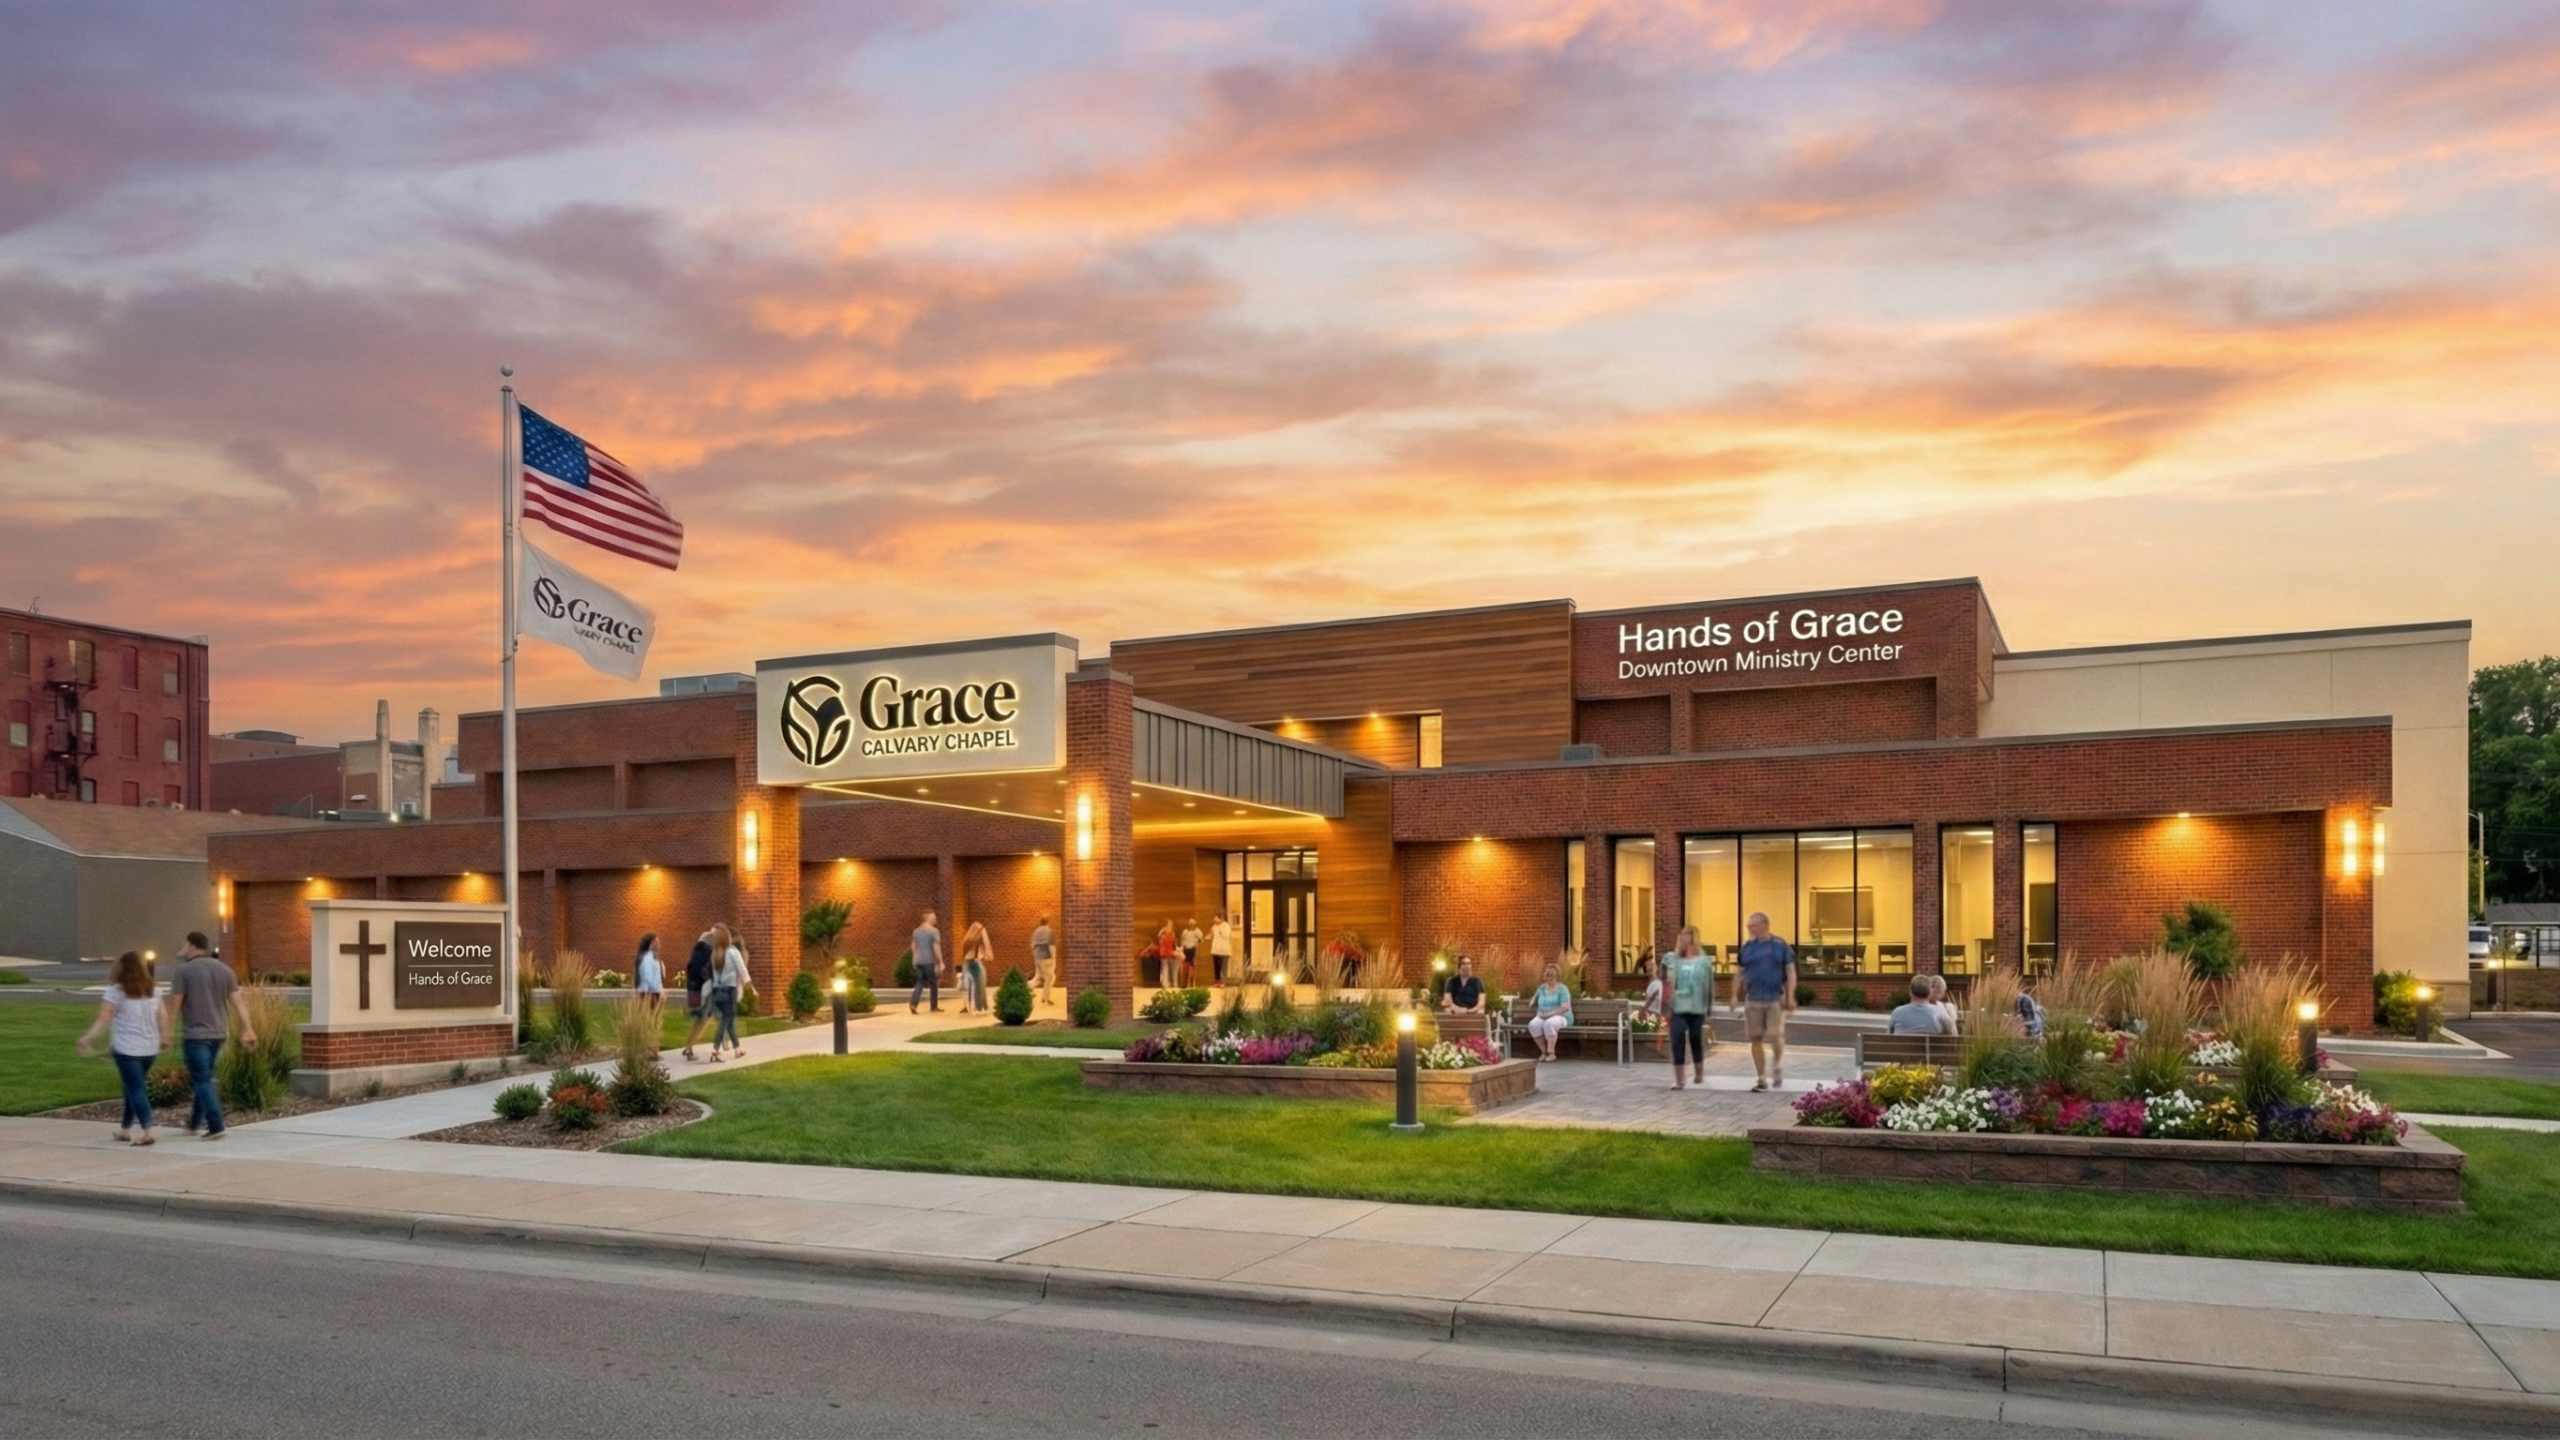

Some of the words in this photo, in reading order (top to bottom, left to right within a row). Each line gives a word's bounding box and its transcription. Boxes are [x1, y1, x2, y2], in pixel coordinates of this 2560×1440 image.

[567, 598, 643, 643] Grace
[1618, 617, 1732, 654] Hands
[1743, 611, 1780, 644] of
[1790, 608, 1903, 640] Grace
[1618, 657, 1728, 679] Downtown
[1736, 650, 1822, 671] Ministry
[1828, 643, 1903, 664] Center
[859, 675, 1016, 731] Grace
[860, 734, 941, 757] CALVARY
[944, 729, 1016, 751] CHAPEL
[408, 938, 492, 958] Welcome
[408, 971, 445, 986] Hands
[446, 970, 459, 985] of
[460, 970, 493, 985] Grace
